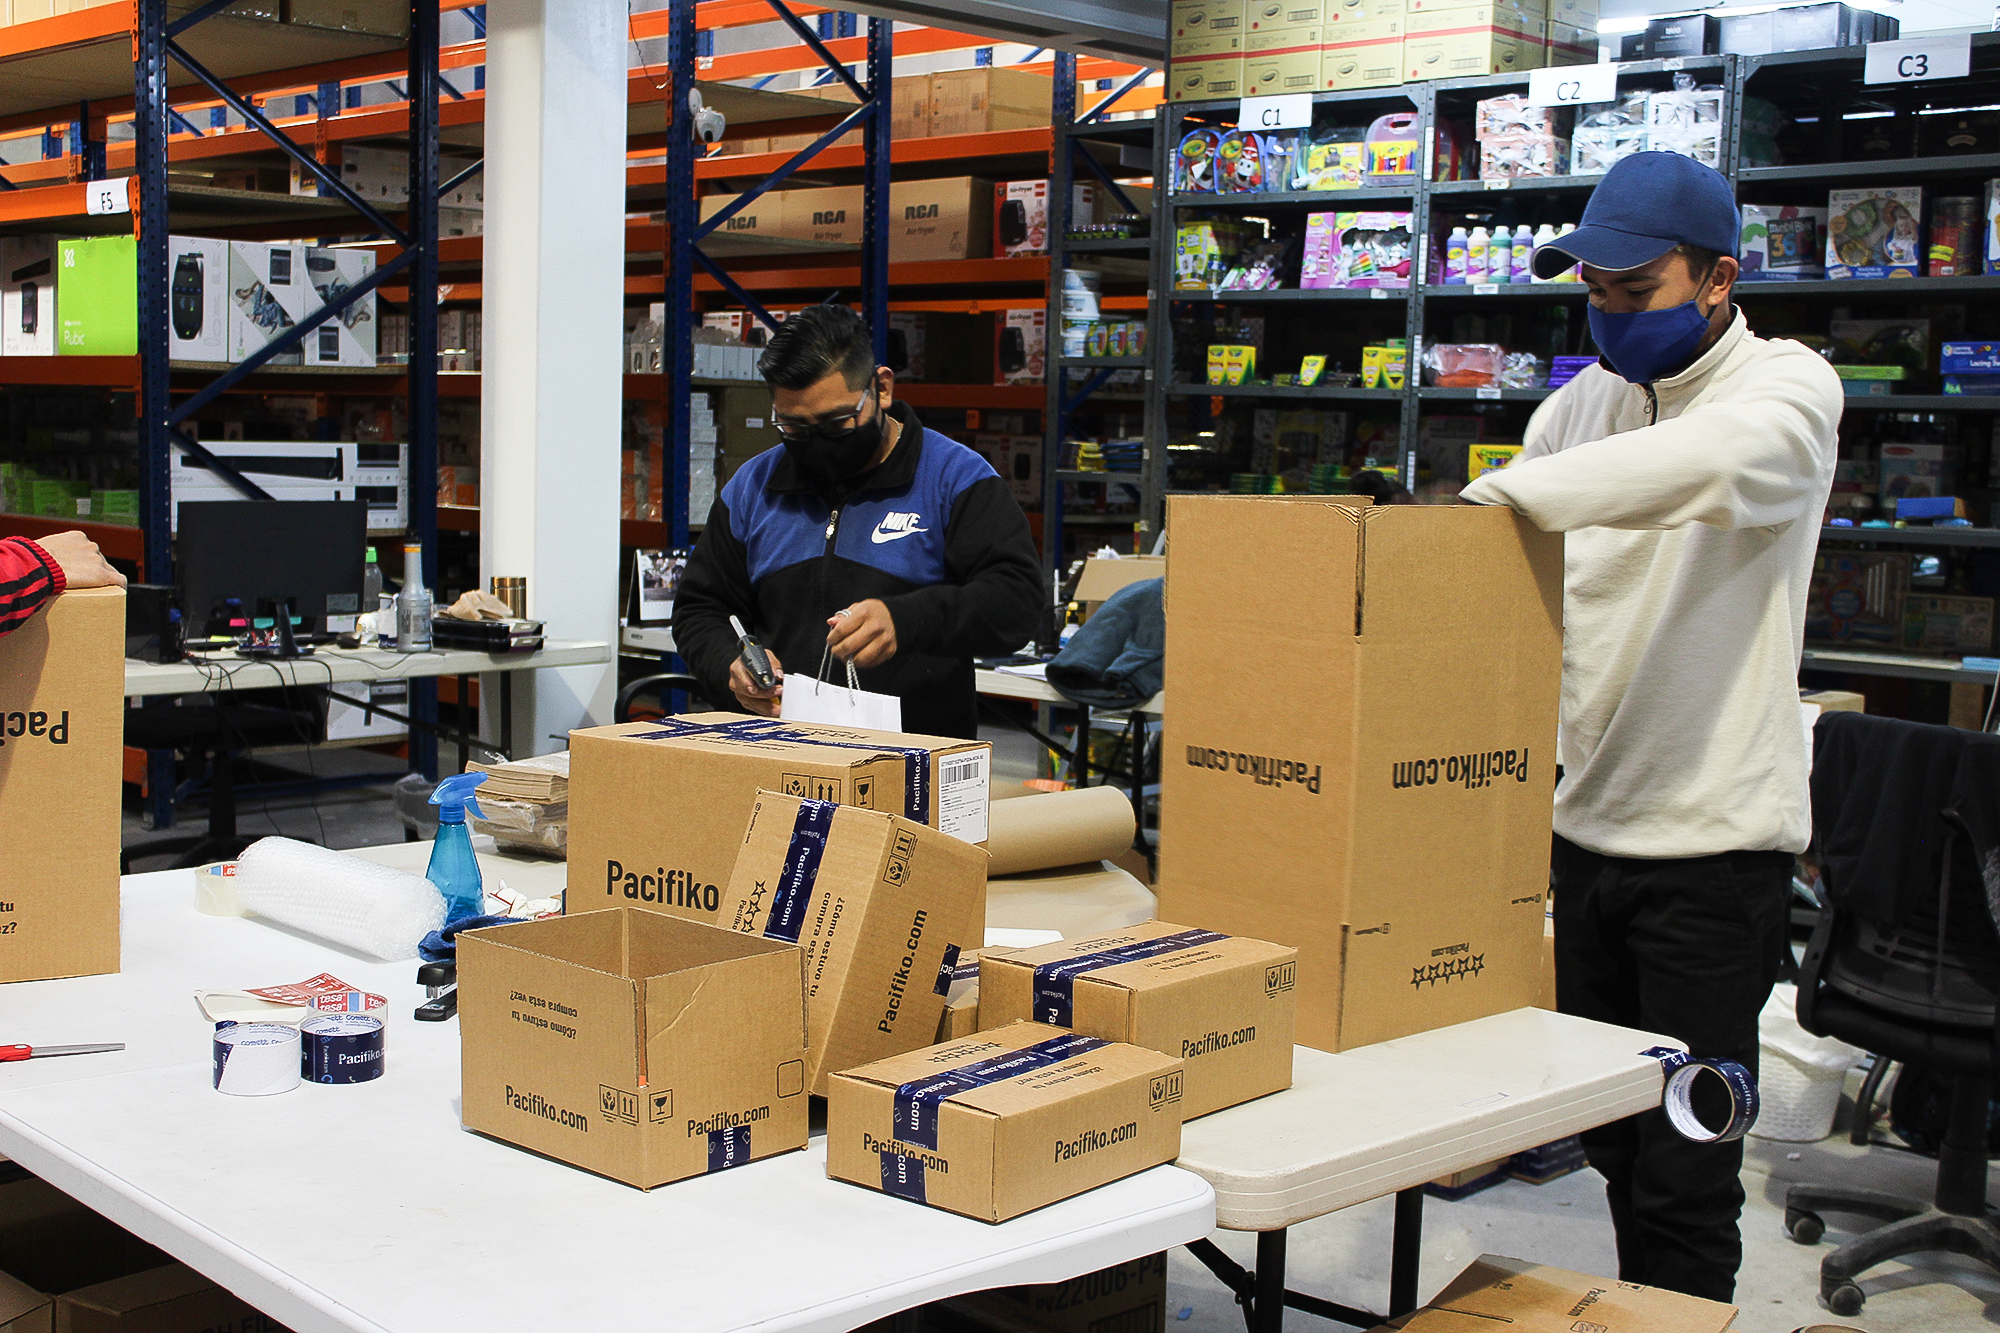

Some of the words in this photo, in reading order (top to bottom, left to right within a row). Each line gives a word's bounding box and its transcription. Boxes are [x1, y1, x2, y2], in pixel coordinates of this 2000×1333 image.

[1898, 55, 1928, 78] C3
[1557, 82, 1581, 101] C2
[1261, 108, 1282, 127] C1
[100, 191, 114, 211] F5
[812, 210, 846, 226] RCA
[904, 203, 939, 221] RCA
[726, 215, 757, 231] RCA
[880, 511, 921, 530] NIKE
[1185, 744, 1322, 795] Pacifiko.com
[1392, 747, 1530, 790] Pacifiko.com
[606, 859, 721, 912] Pacifiko
[780, 847, 811, 927] Pacifiko.com
[731, 899, 747, 931] Pacifiko
[813, 892, 831, 937] compra
[828, 896, 846, 938] ¿Cómo
[814, 940, 832, 981] estuvo
[877, 909, 928, 1034] Pacifiko.com
[319, 993, 343, 1004] tesa
[509, 990, 527, 1003] vez?
[809, 984, 820, 998] tu
[319, 1002, 343, 1013] tesa
[528, 995, 546, 1009] esta
[547, 1001, 578, 1018] compra
[511, 1010, 521, 1022] tu
[522, 1013, 549, 1030] estuvo
[550, 1021, 577, 1040] ¿Cómo
[1181, 1024, 1256, 1059] Pacifiko.com
[505, 1084, 588, 1134] Pacifiko.com
[687, 1104, 770, 1139] Pacifiko.com
[1054, 1119, 1138, 1164] Pacifiko.com
